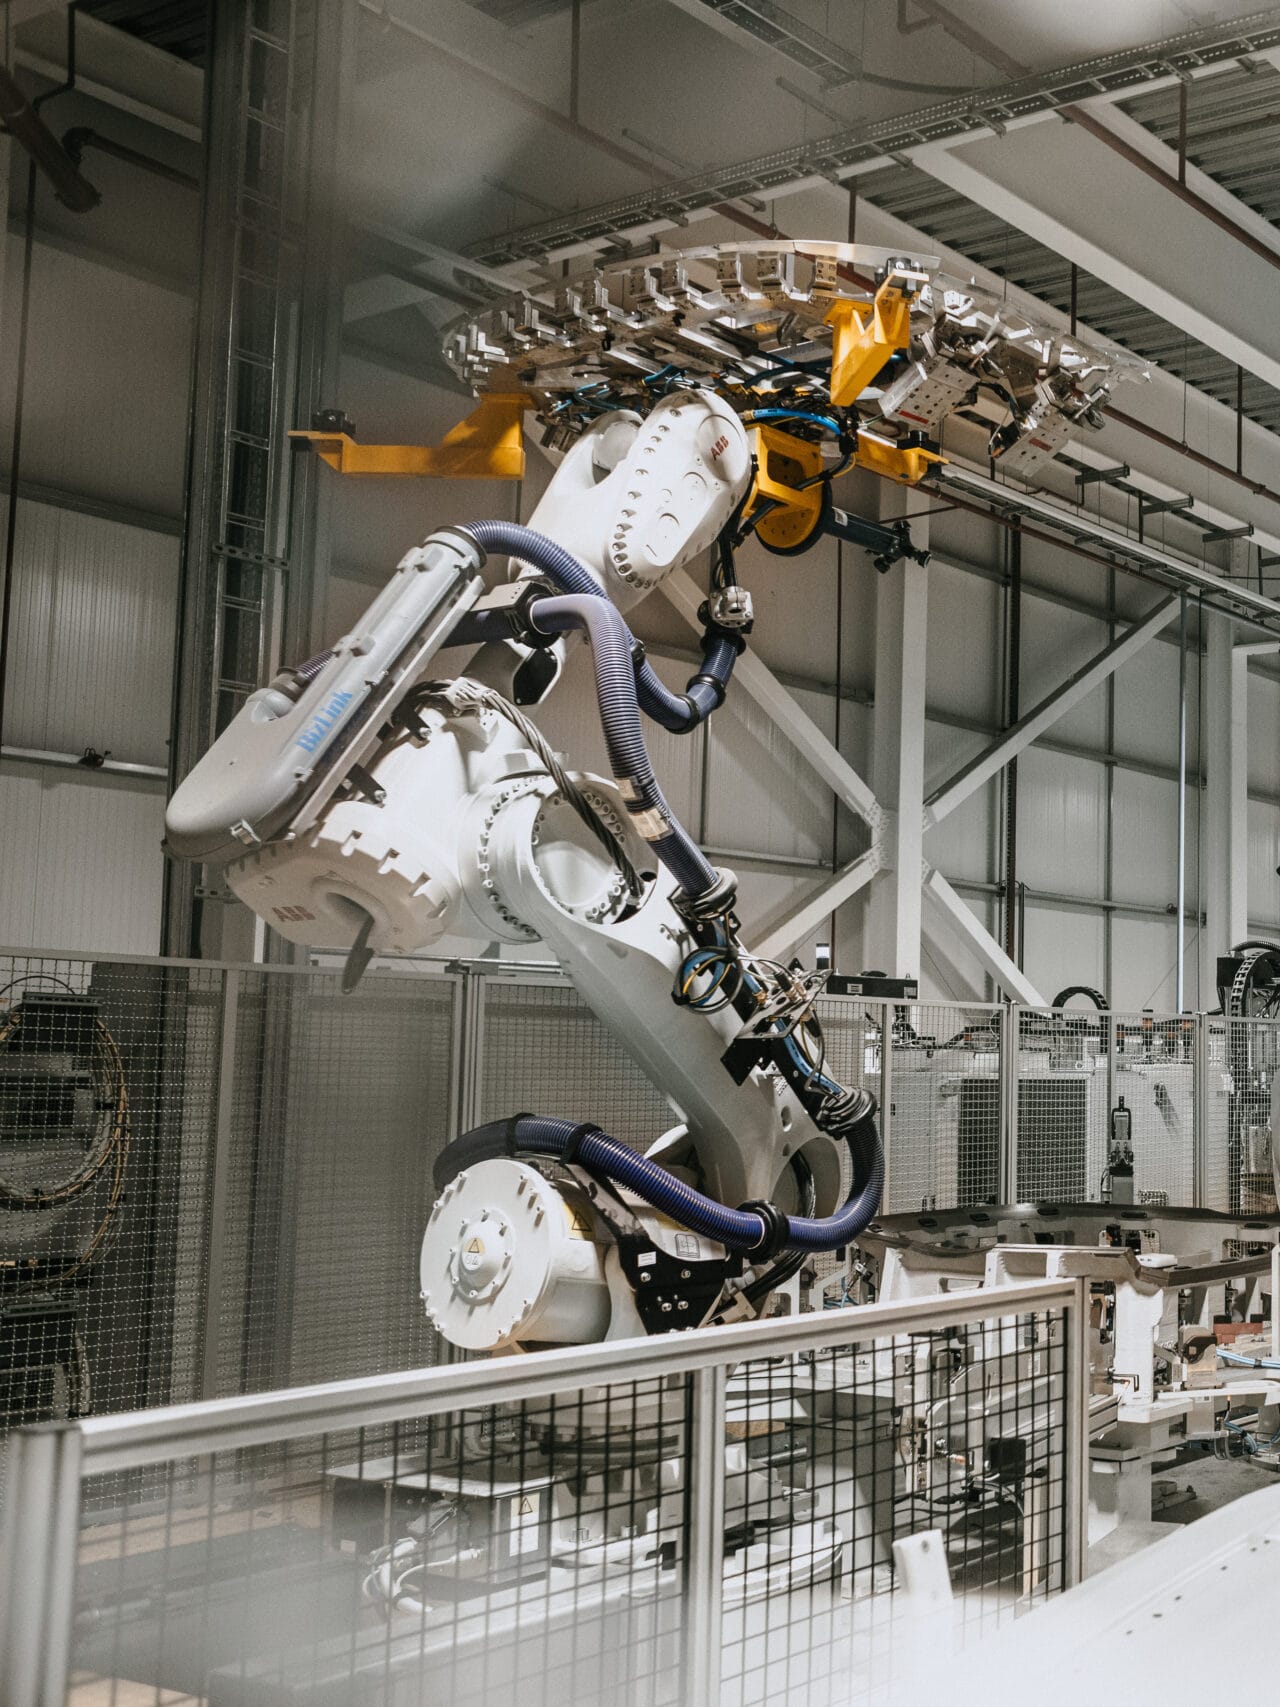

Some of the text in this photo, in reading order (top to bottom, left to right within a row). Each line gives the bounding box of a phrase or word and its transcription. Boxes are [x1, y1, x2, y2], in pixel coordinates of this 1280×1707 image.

[710, 435, 729, 461] ABB
[295, 688, 353, 753] BizLink
[271, 905, 316, 922] ABB
